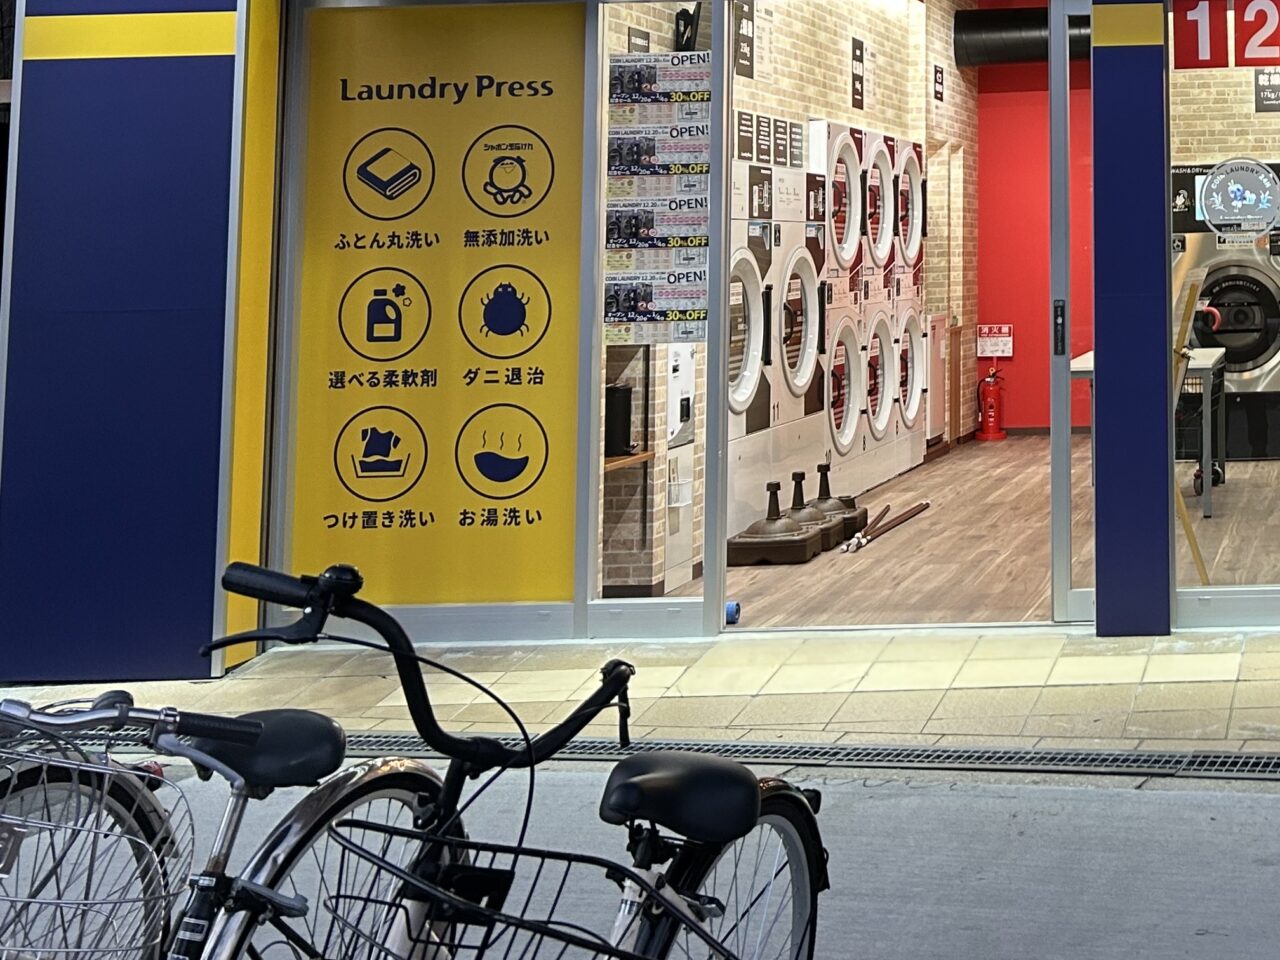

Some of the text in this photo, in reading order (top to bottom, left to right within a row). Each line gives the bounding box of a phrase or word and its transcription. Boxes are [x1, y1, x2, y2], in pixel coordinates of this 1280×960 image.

[671, 54, 709, 67] OPEN!
[339, 75, 554, 104] Laundry Press
[670, 124, 708, 138] OPEN!
[1225, 166, 1260, 176] LAUNDRY
[668, 197, 707, 211] OPEN!
[334, 231, 440, 250] ふとん丸洗い
[463, 228, 550, 248] 無添加洗い
[667, 270, 706, 284] OPEN!
[328, 369, 438, 388] 選べる柔軟剤
[463, 367, 545, 386] ダニ退治
[772, 401, 780, 422] 11
[323, 510, 435, 530] つけ置き洗い
[459, 508, 543, 527] お湯洗い
